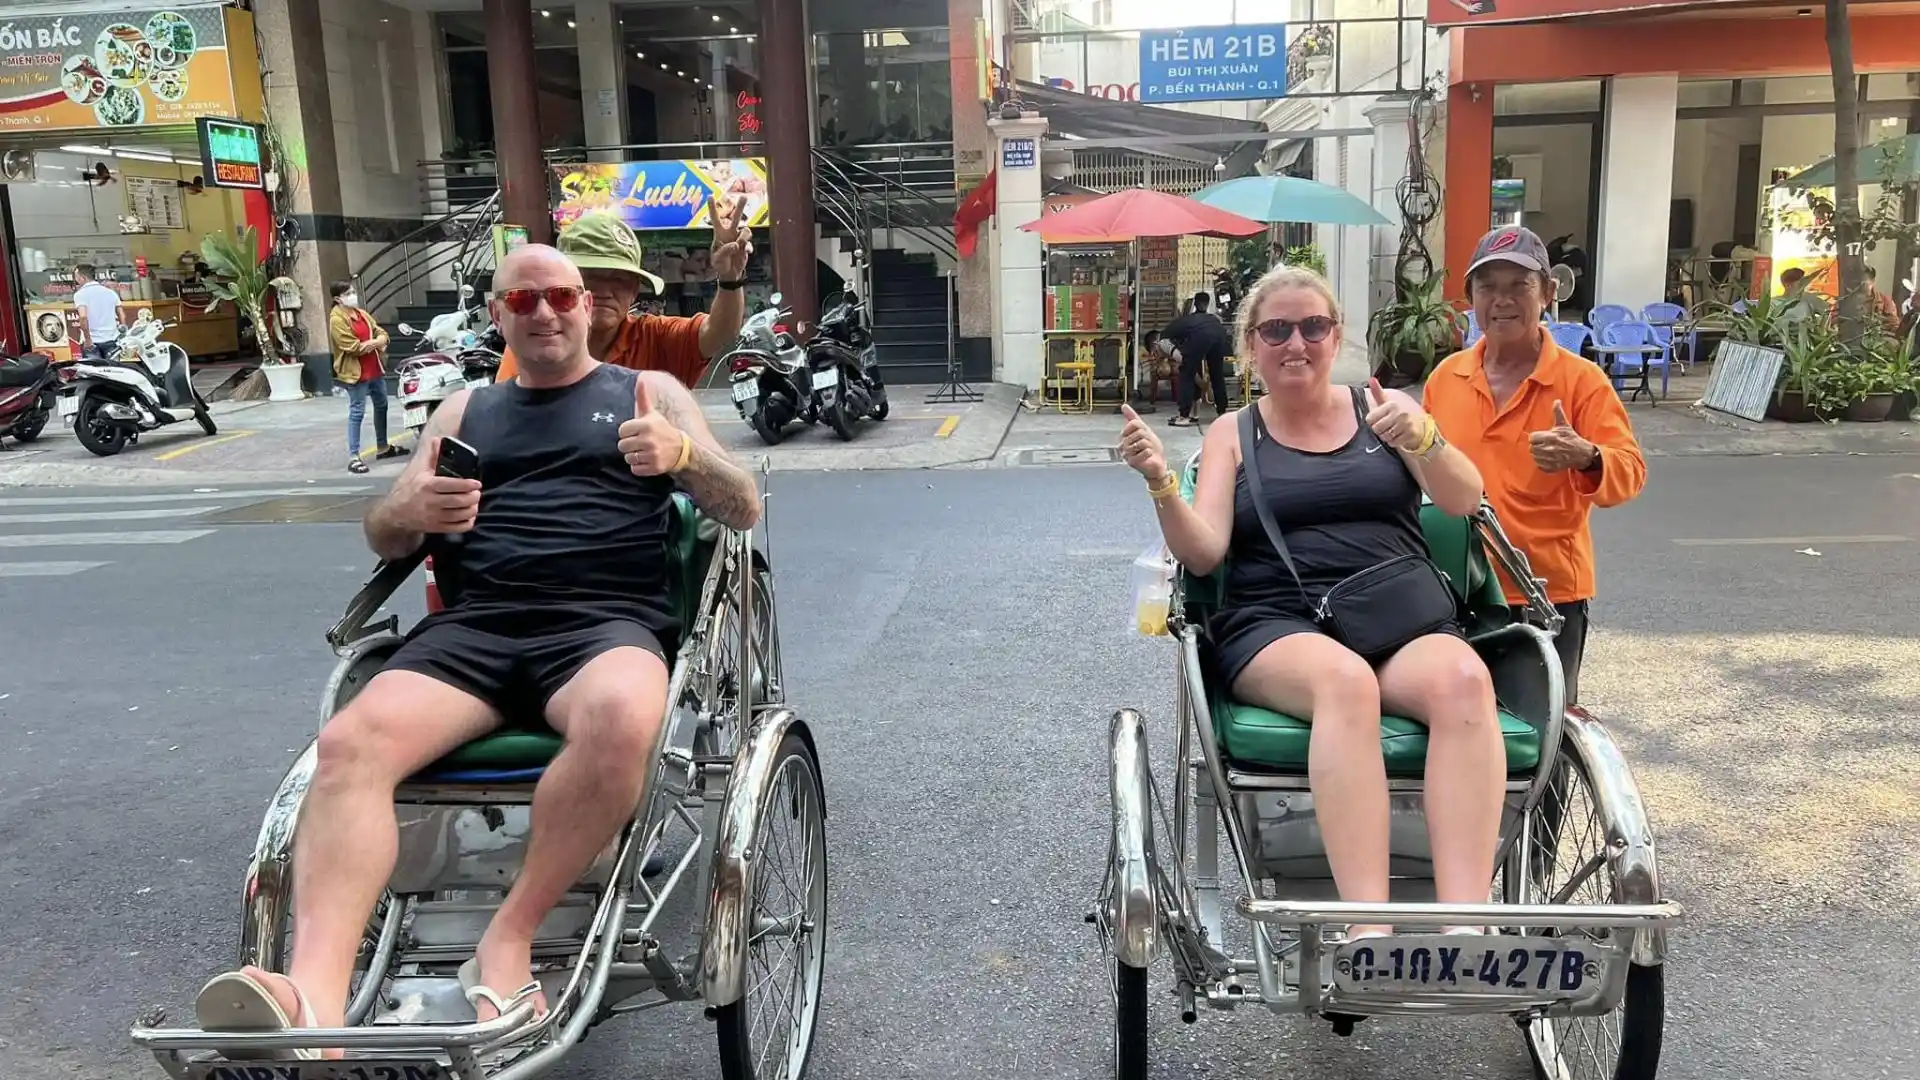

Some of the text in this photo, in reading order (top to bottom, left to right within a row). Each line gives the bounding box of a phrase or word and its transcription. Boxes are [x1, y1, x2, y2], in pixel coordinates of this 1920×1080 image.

[37, 17, 82, 48] BẮC
[1151, 29, 1277, 61] HẺM 21B
[1221, 62, 1259, 75] XUÂN
[1149, 85, 1162, 95] P.
[1199, 81, 1245, 93] THÀNH
[1257, 80, 1278, 90] Q.1
[217, 163, 258, 182] RESTAURANT
[622, 170, 703, 216] Lucky
[1845, 241, 1862, 256] 17
